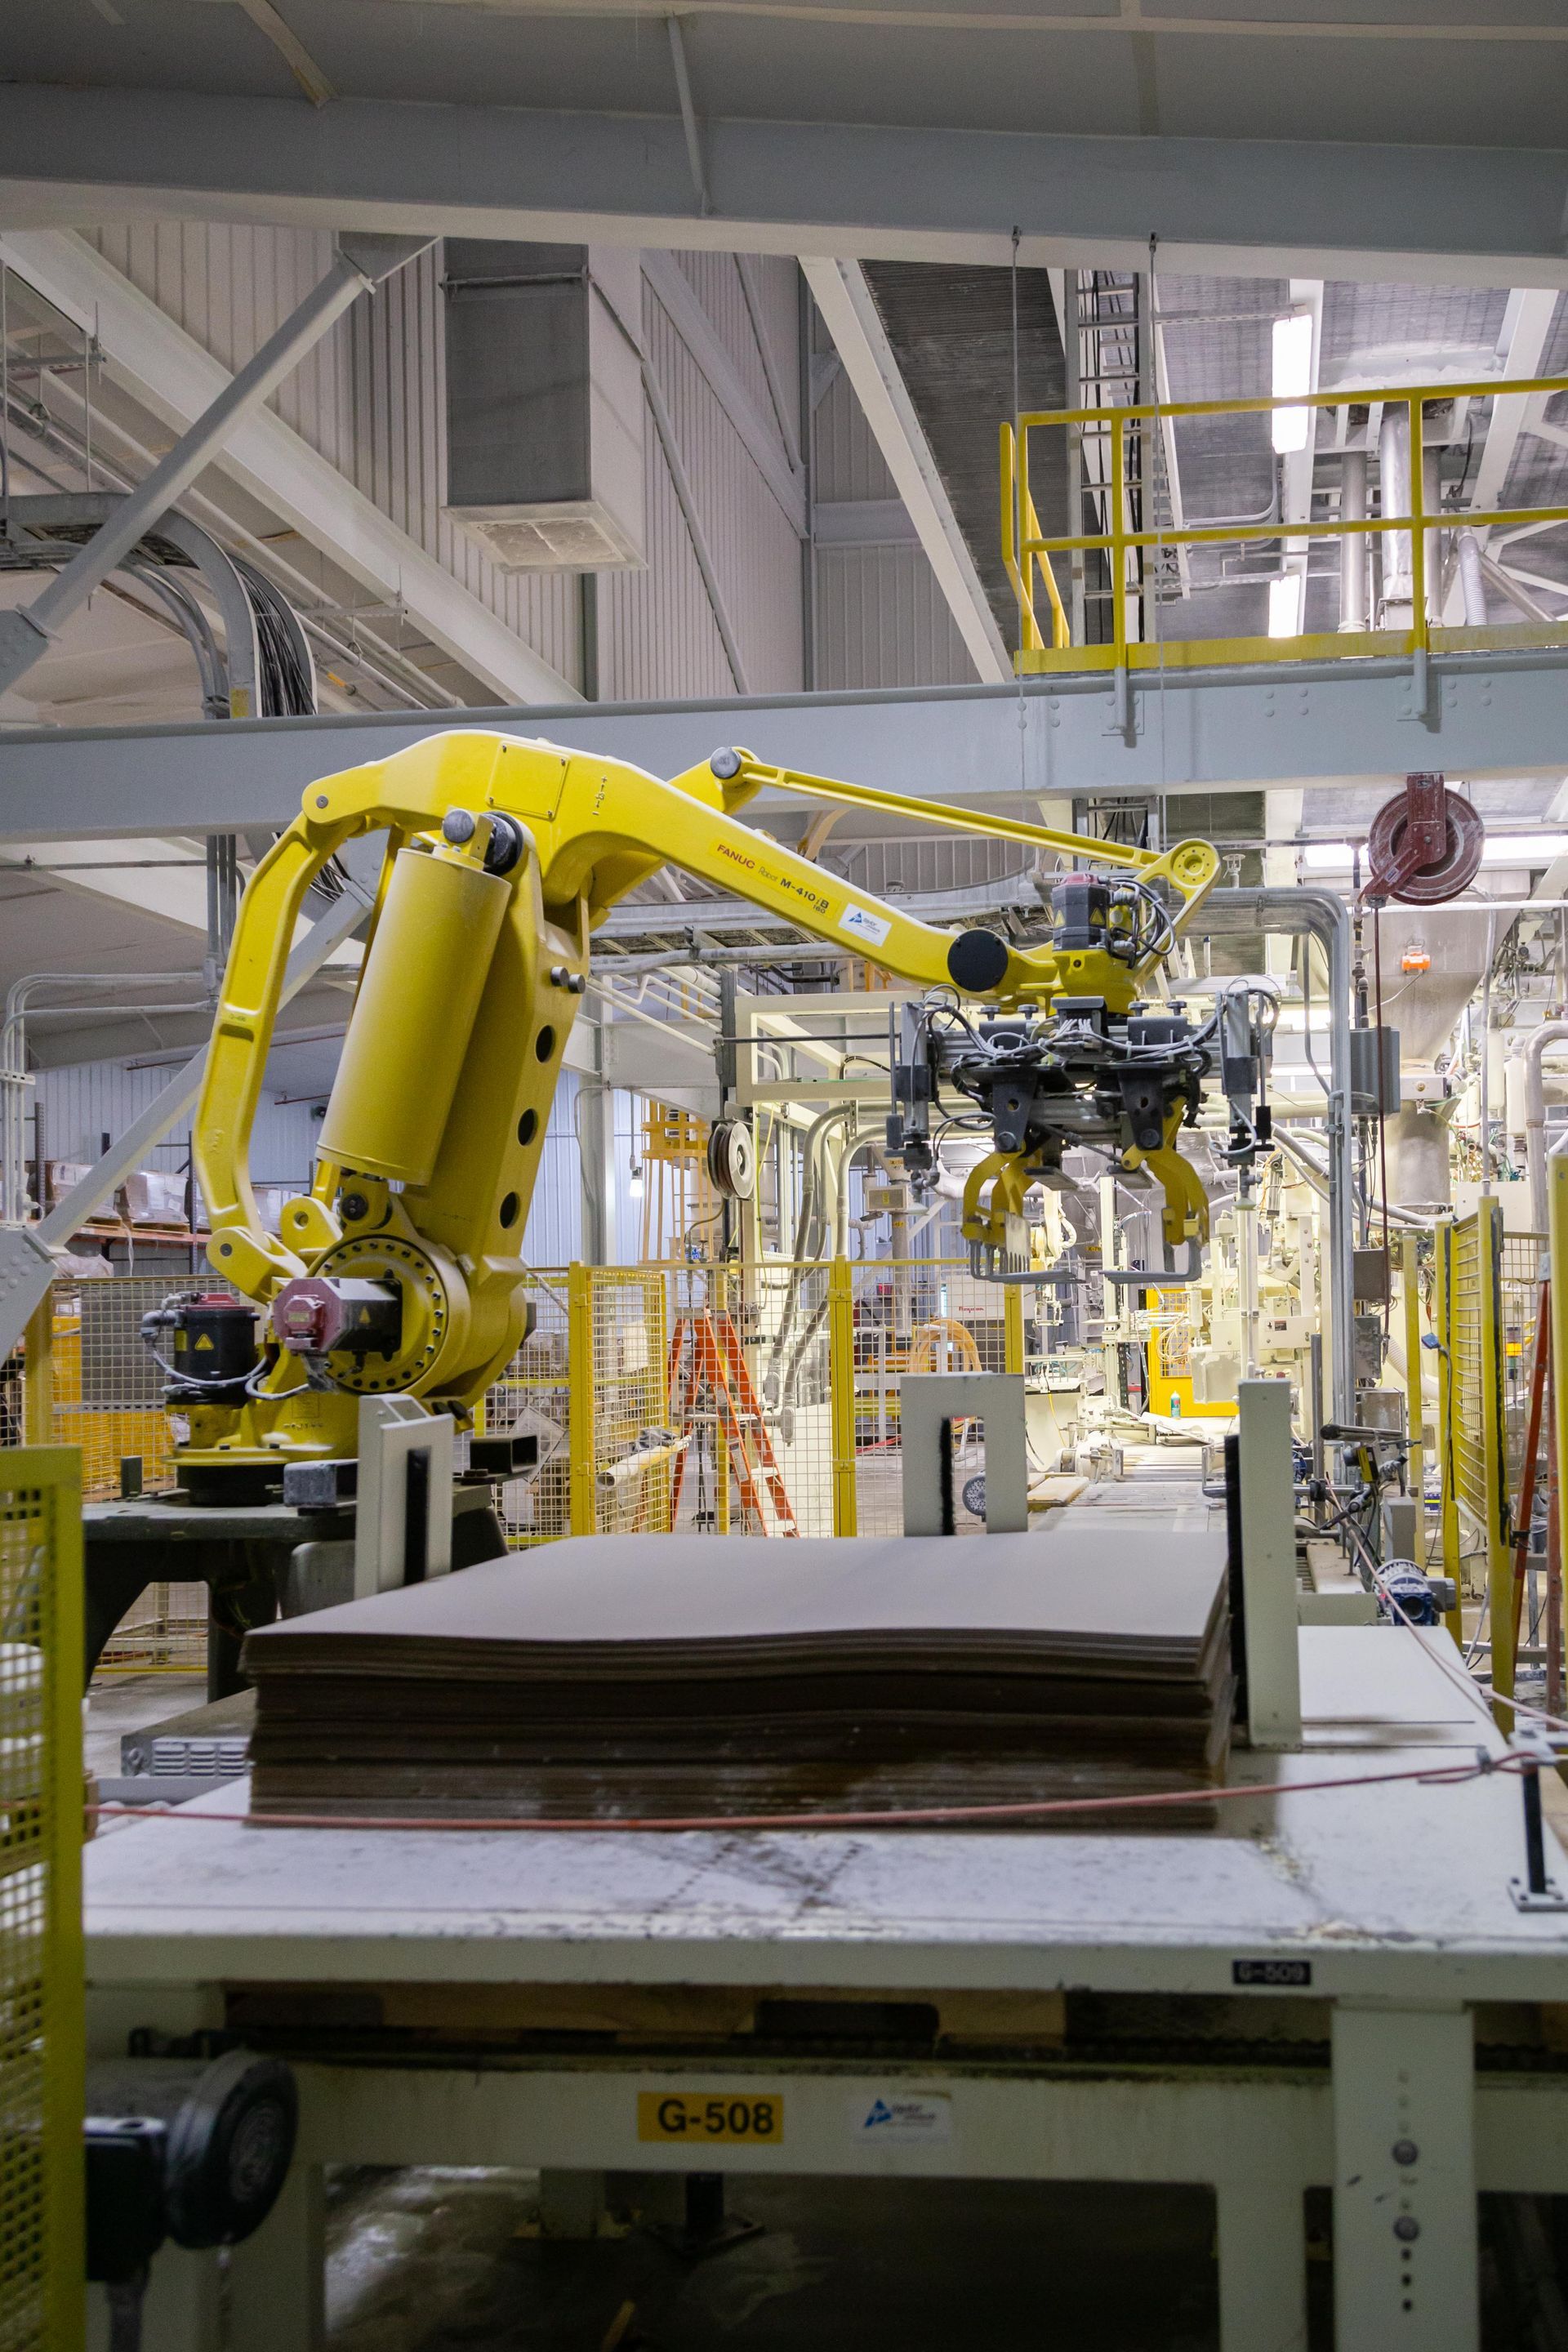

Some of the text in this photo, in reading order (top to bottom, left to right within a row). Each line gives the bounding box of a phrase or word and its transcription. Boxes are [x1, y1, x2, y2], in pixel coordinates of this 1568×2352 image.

[717, 844, 755, 869] FANUC
[759, 866, 777, 881] Robot
[657, 2099, 773, 2134] G-508
